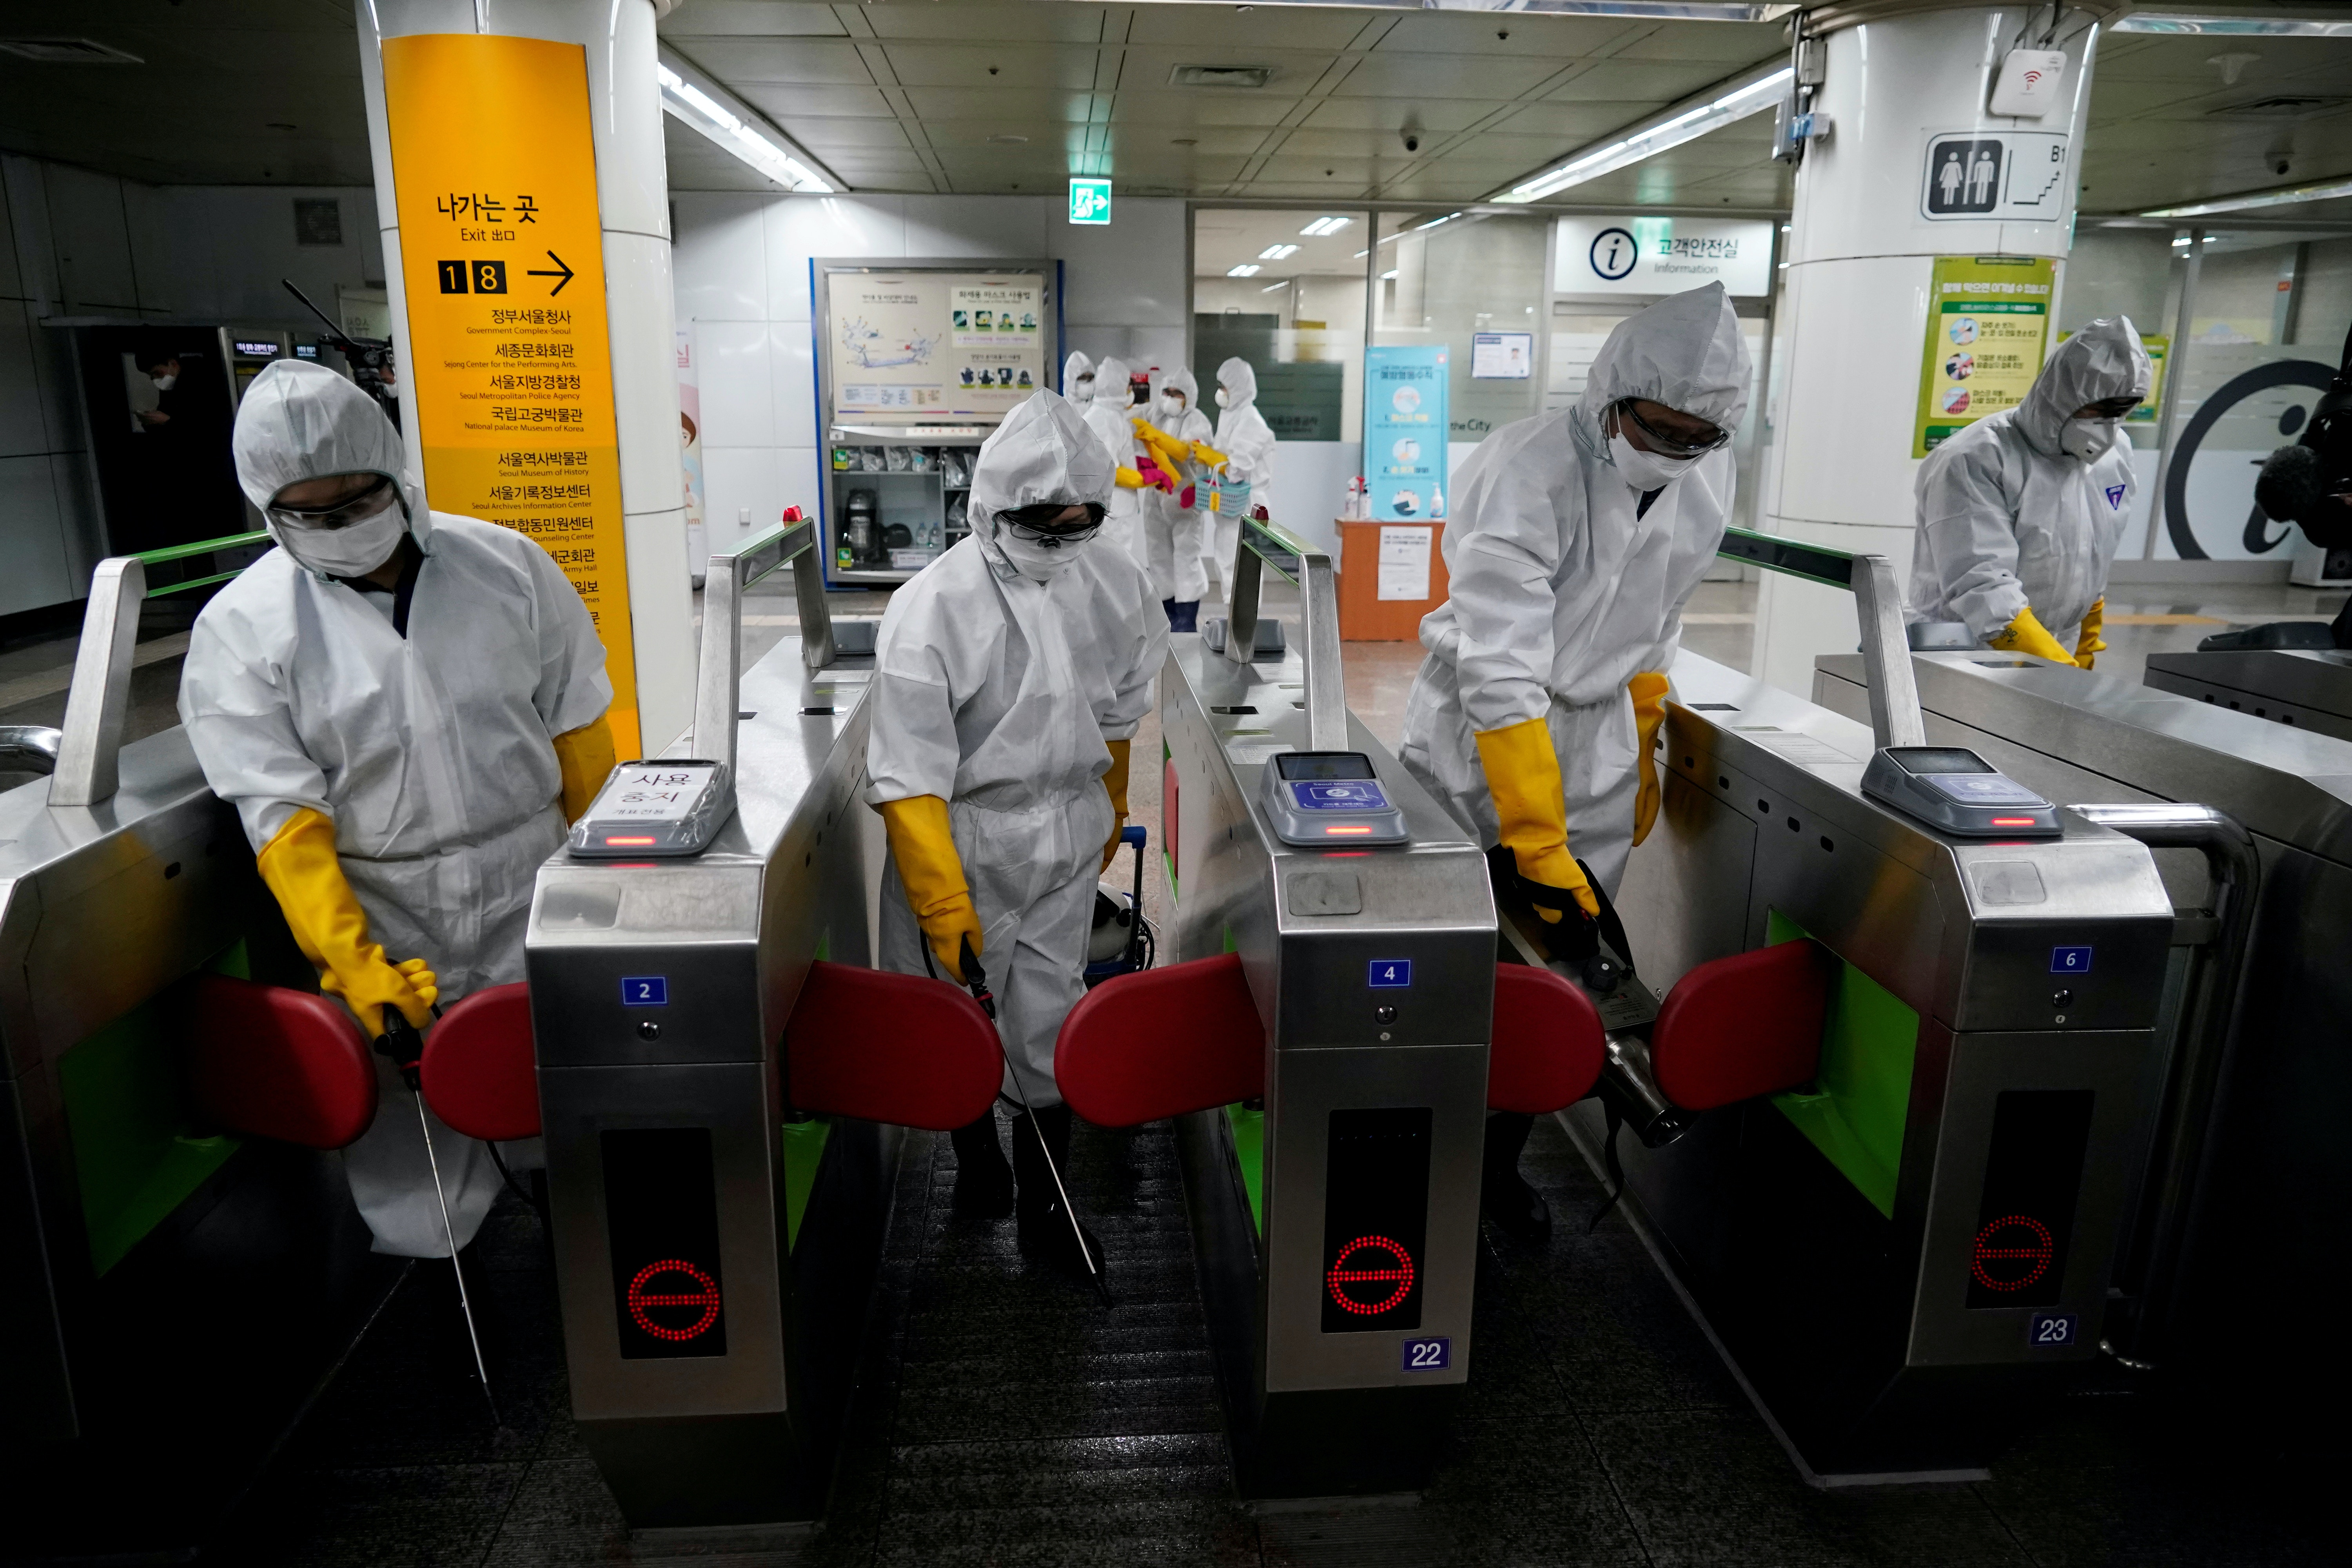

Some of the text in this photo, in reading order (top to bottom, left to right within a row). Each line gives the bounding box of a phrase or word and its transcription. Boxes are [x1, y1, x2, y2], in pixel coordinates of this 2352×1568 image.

[2051, 145, 2065, 163] B1
[437, 193, 539, 223] 나가는 곳
[461, 229, 515, 241] Exit 出口
[1657, 238, 1738, 258] 고객안전실
[446, 265, 497, 290] 1 8
[492, 309, 571, 325] 정부서울청사
[495, 343, 574, 358] 세종문화회관
[490, 374, 581, 390] 서울지방경찰청
[479, 392, 526, 401] Metropolitan
[491, 406, 583, 423] 국립고궁박물관
[494, 423, 518, 432] palace
[1467, 418, 1491, 432] City
[498, 451, 588, 467] 서울역사박물관
[490, 484, 591, 500] 서울기록정보센터
[571, 581, 599, 594] 일보
[632, 774, 691, 786] 사용
[620, 791, 679, 802] 중지
[2066, 953, 2076, 966] 6
[1384, 966, 1395, 980] 4
[639, 983, 650, 998] 2
[2038, 1319, 2068, 1342] 23
[1412, 1343, 1441, 1367] 22
